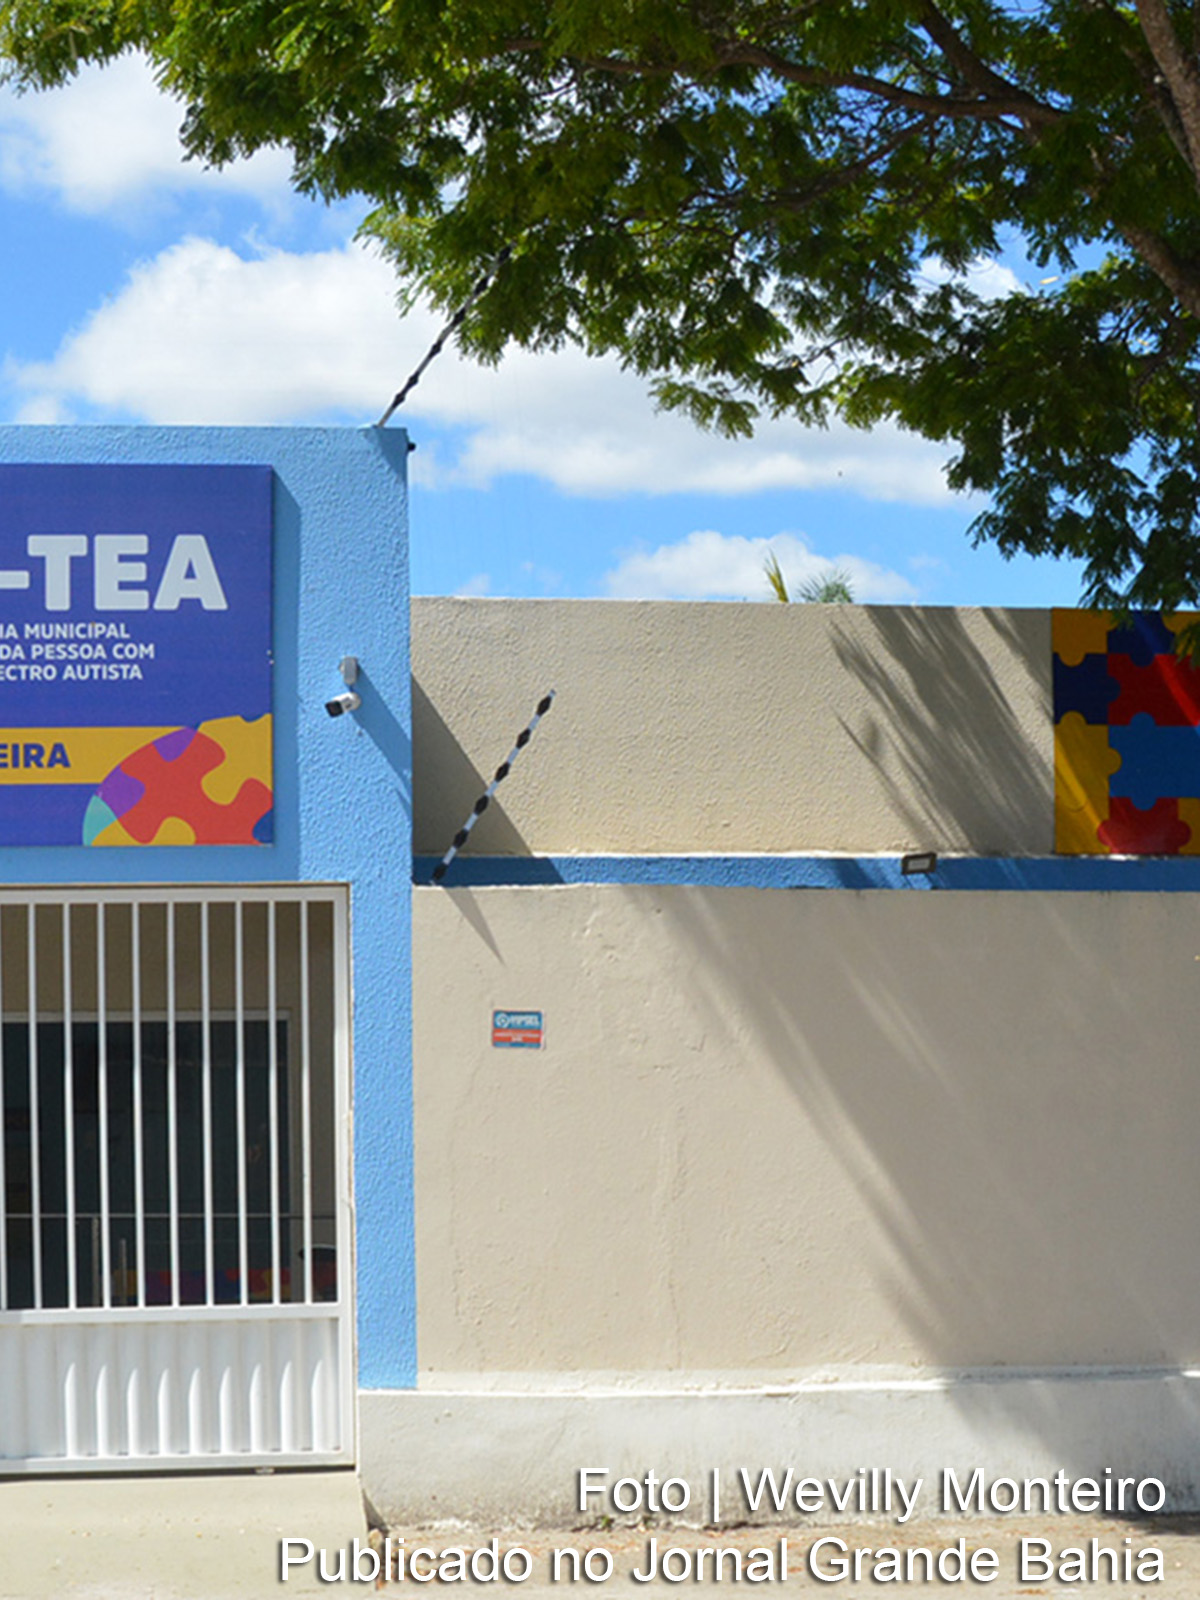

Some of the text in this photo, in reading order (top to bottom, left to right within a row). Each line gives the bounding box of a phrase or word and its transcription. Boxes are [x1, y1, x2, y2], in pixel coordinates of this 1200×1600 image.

[24, 622, 131, 640] MUNICIPAL
[31, 643, 107, 660] PESSOA
[112, 642, 155, 660] COM
[62, 663, 143, 681] AUTISTA
